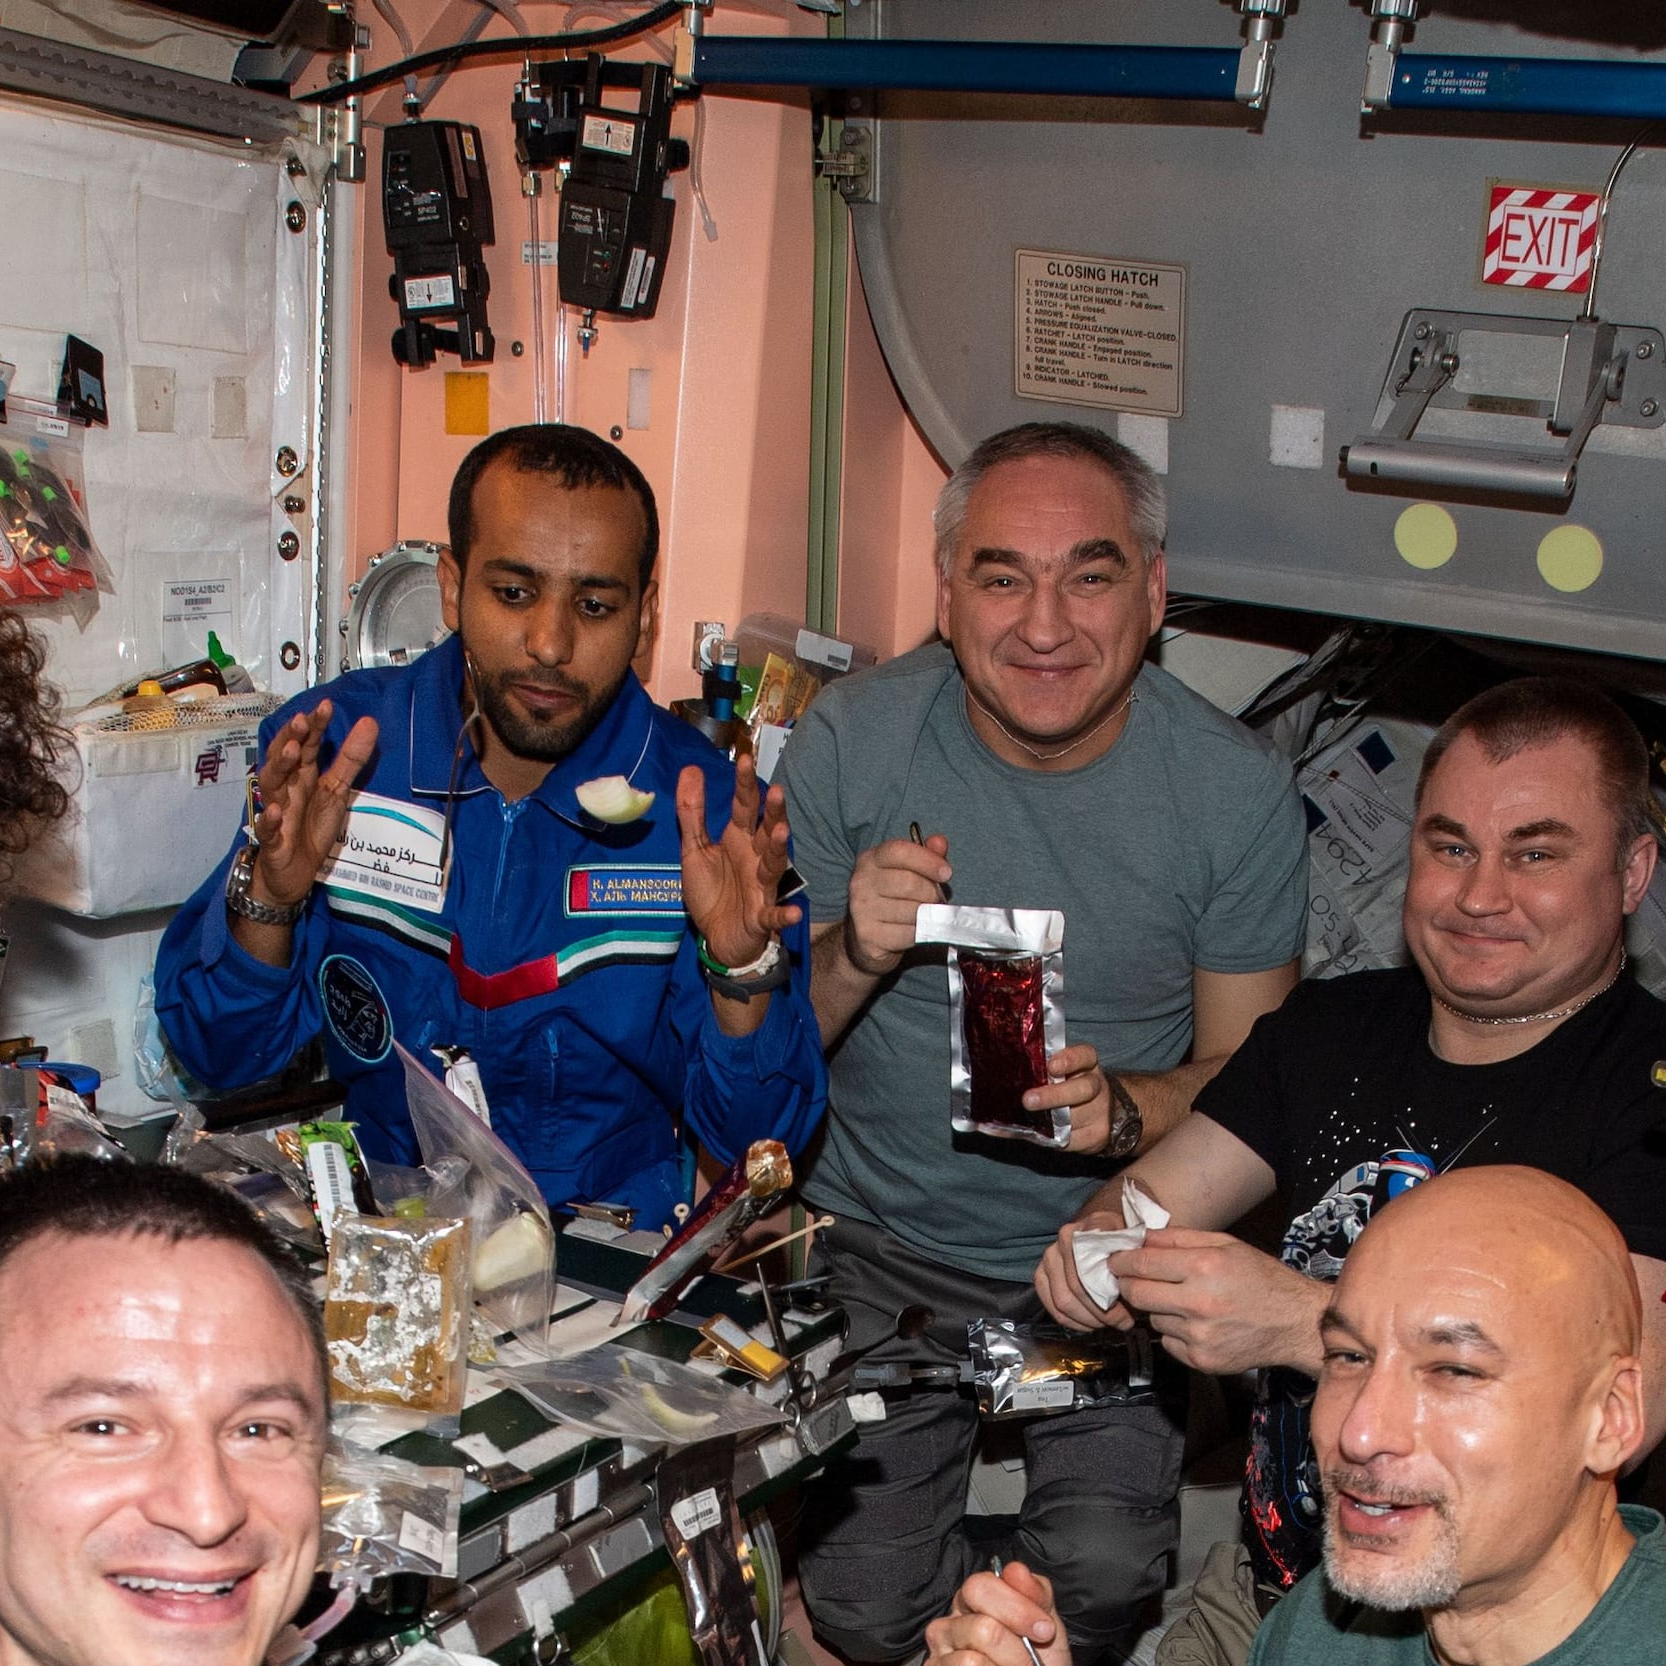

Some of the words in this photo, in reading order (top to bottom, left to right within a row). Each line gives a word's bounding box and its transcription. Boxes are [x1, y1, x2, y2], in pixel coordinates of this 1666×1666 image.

[1501, 213, 1579, 267] EXIT
[1047, 262, 1106, 281] CLOSING
[1111, 270, 1159, 287] HATCH
[1034, 280, 1069, 292] STOWAGE
[1070, 283, 1094, 293] LATCH
[1095, 286, 1124, 296] BUTTON
[1034, 290, 1069, 301] STOWAGE
[1070, 294, 1094, 304] LATCH
[1094, 297, 1123, 307] HANDLE
[1034, 299, 1058, 309] HATCH
[1034, 309, 1064, 319] ARROWS
[1034, 318, 1068, 329] PRESSURE
[1069, 322, 1119, 335] EQUALIZATION
[1034, 328, 1065, 338] RATCHET
[1072, 332, 1096, 342] LATCH
[1034, 337, 1057, 347] CRANK
[1058, 340, 1086, 351] HANDLE
[1034, 346, 1057, 356] CRANK
[1058, 349, 1086, 360] HANDLE
[1117, 356, 1141, 367] LATCH
[1142, 360, 1173, 371] direction
[1034, 365, 1070, 376] INDICATOR
[1077, 370, 1110, 381] LATCHED.
[1034, 373, 1057, 384] CRANK
[1058, 377, 1085, 387] HANDLE
[393, 882, 415, 898] SPACE
